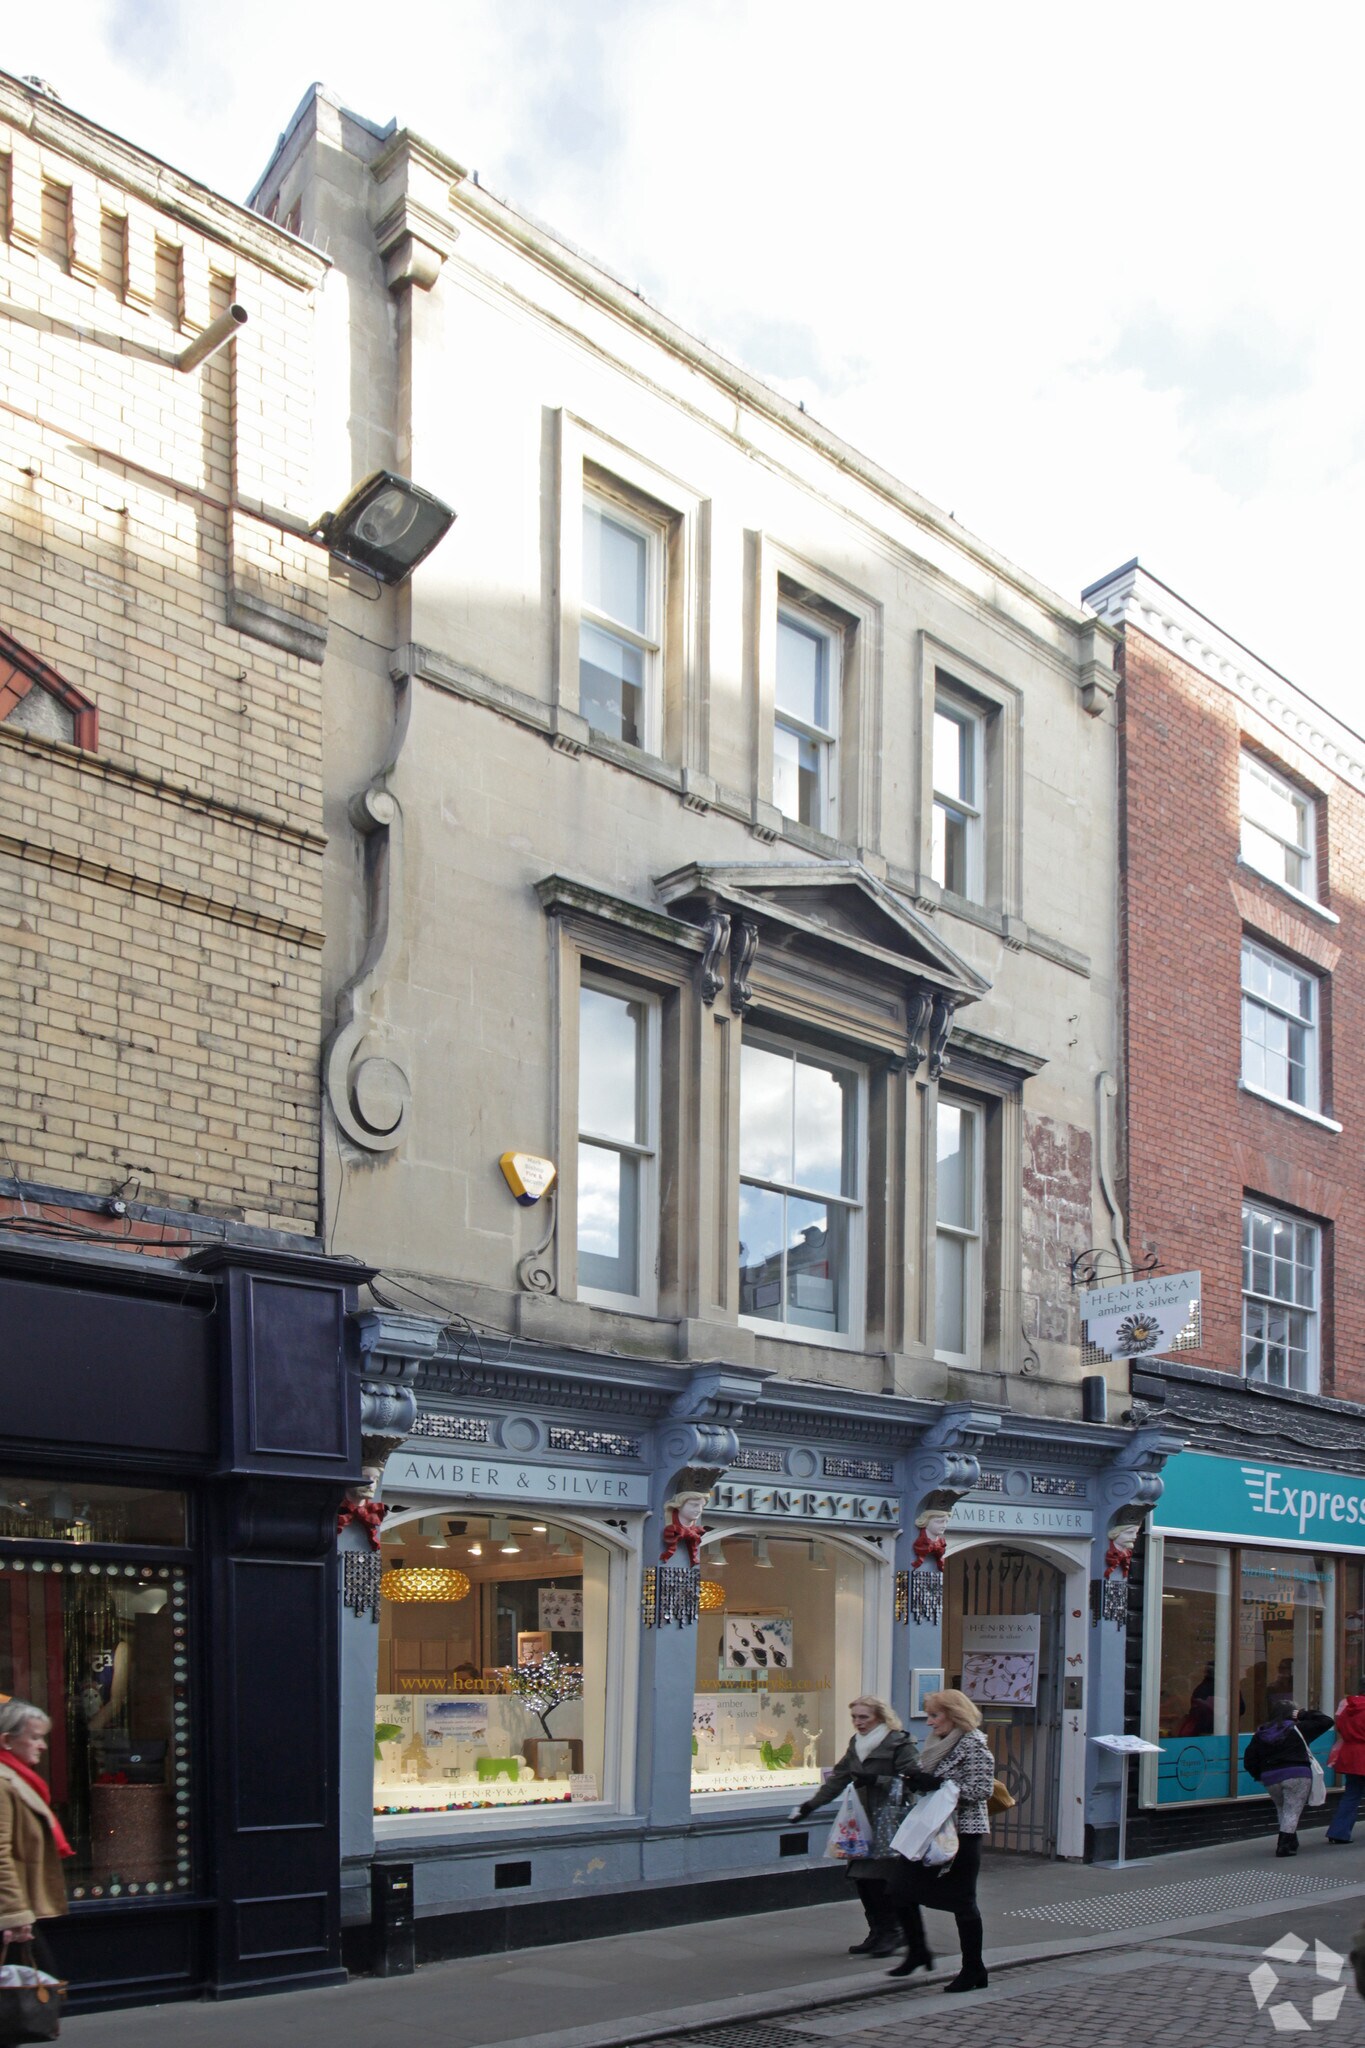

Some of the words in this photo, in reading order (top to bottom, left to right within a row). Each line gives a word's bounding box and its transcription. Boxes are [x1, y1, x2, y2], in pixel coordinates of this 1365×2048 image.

[1098, 1304, 1132, 1317] amber
[1135, 1300, 1145, 1310] &
[1149, 1295, 1180, 1308] silver
[404, 1461, 499, 1486] AMBER
[516, 1472, 530, 1488] &
[547, 1474, 629, 1497] SILVER
[951, 1507, 1006, 1524] AMBER
[1015, 1511, 1024, 1525] &
[1033, 1512, 1083, 1528] SILVER
[717, 1699, 744, 1709] amber
[381, 1714, 411, 1724] silver
[736, 1709, 759, 1719] silver
